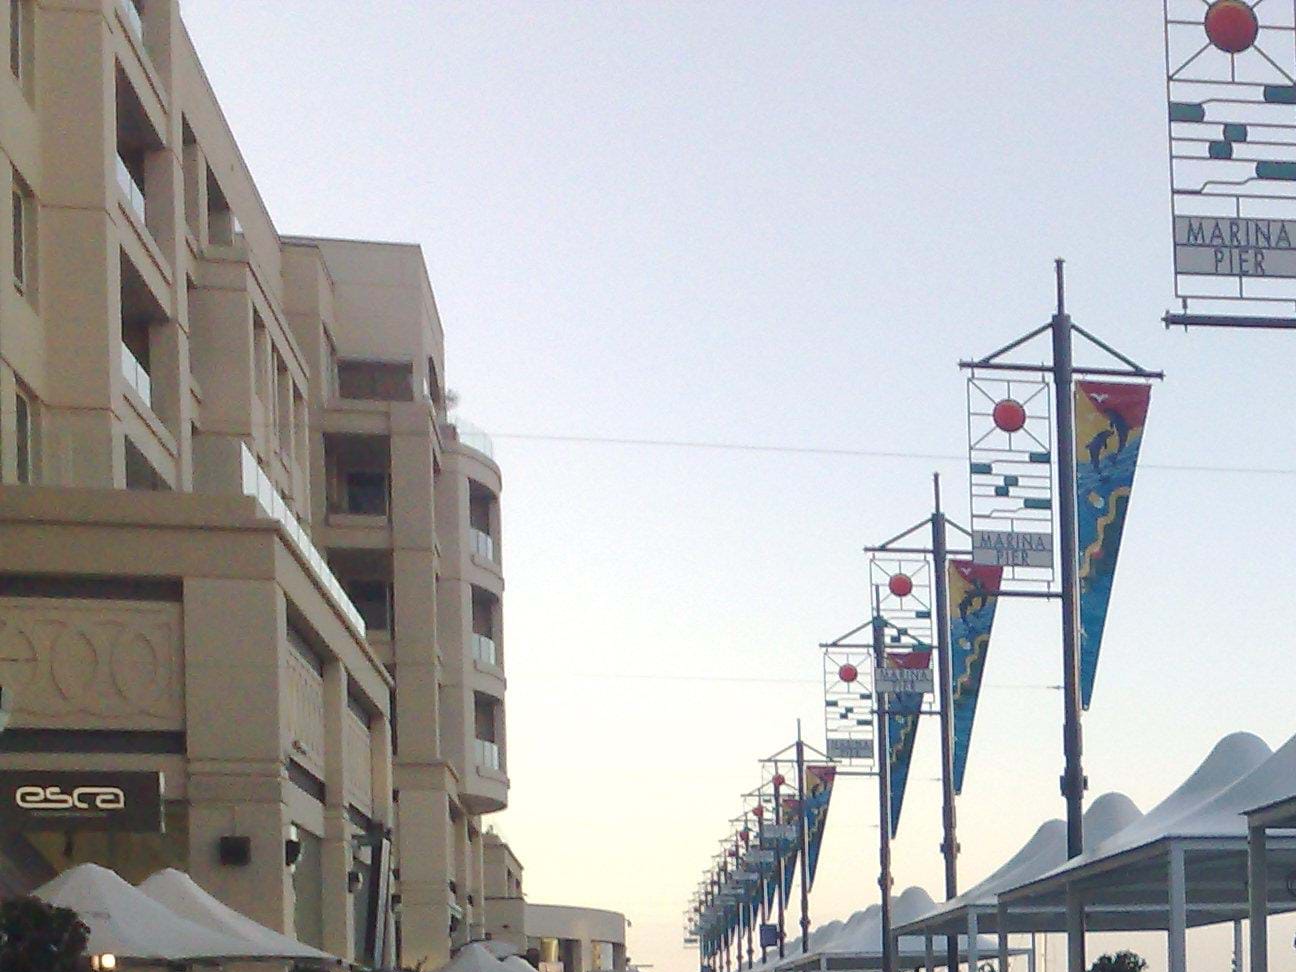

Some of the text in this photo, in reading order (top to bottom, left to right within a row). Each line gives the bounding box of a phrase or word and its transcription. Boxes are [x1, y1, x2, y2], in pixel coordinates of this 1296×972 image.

[1187, 219, 1291, 248] MARINA
[1213, 248, 1265, 276] PIER
[981, 531, 1045, 551] MARINA
[996, 550, 1031, 566] PIER
[15, 786, 125, 809] esca
